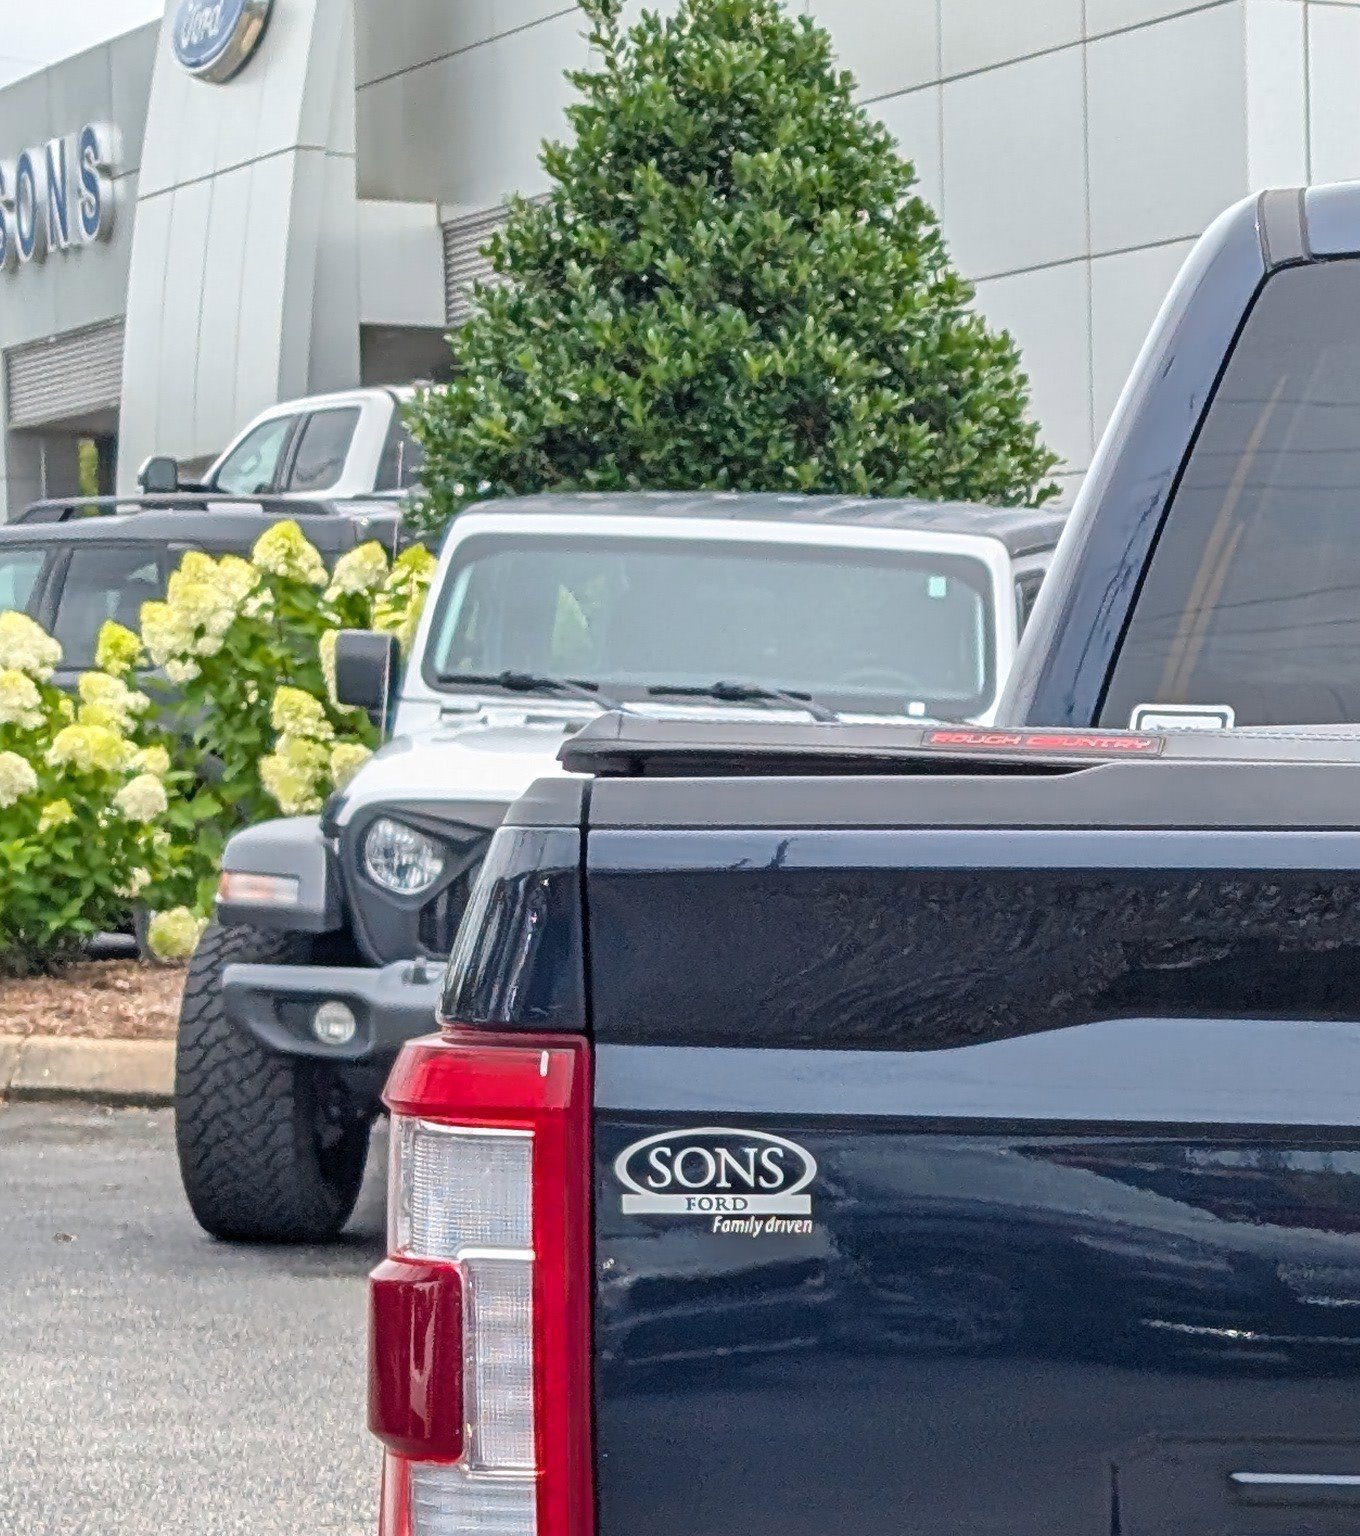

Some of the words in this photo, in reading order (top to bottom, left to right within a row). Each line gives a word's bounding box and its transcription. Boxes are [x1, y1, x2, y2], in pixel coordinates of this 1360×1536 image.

[930, 731, 1022, 745] ROUGH
[1025, 735, 1151, 749] COUNTRY
[647, 1147, 785, 1189] SONS
[685, 1197, 749, 1211] FORD
[712, 1215, 763, 1238] Family
[765, 1215, 813, 1234] driven
